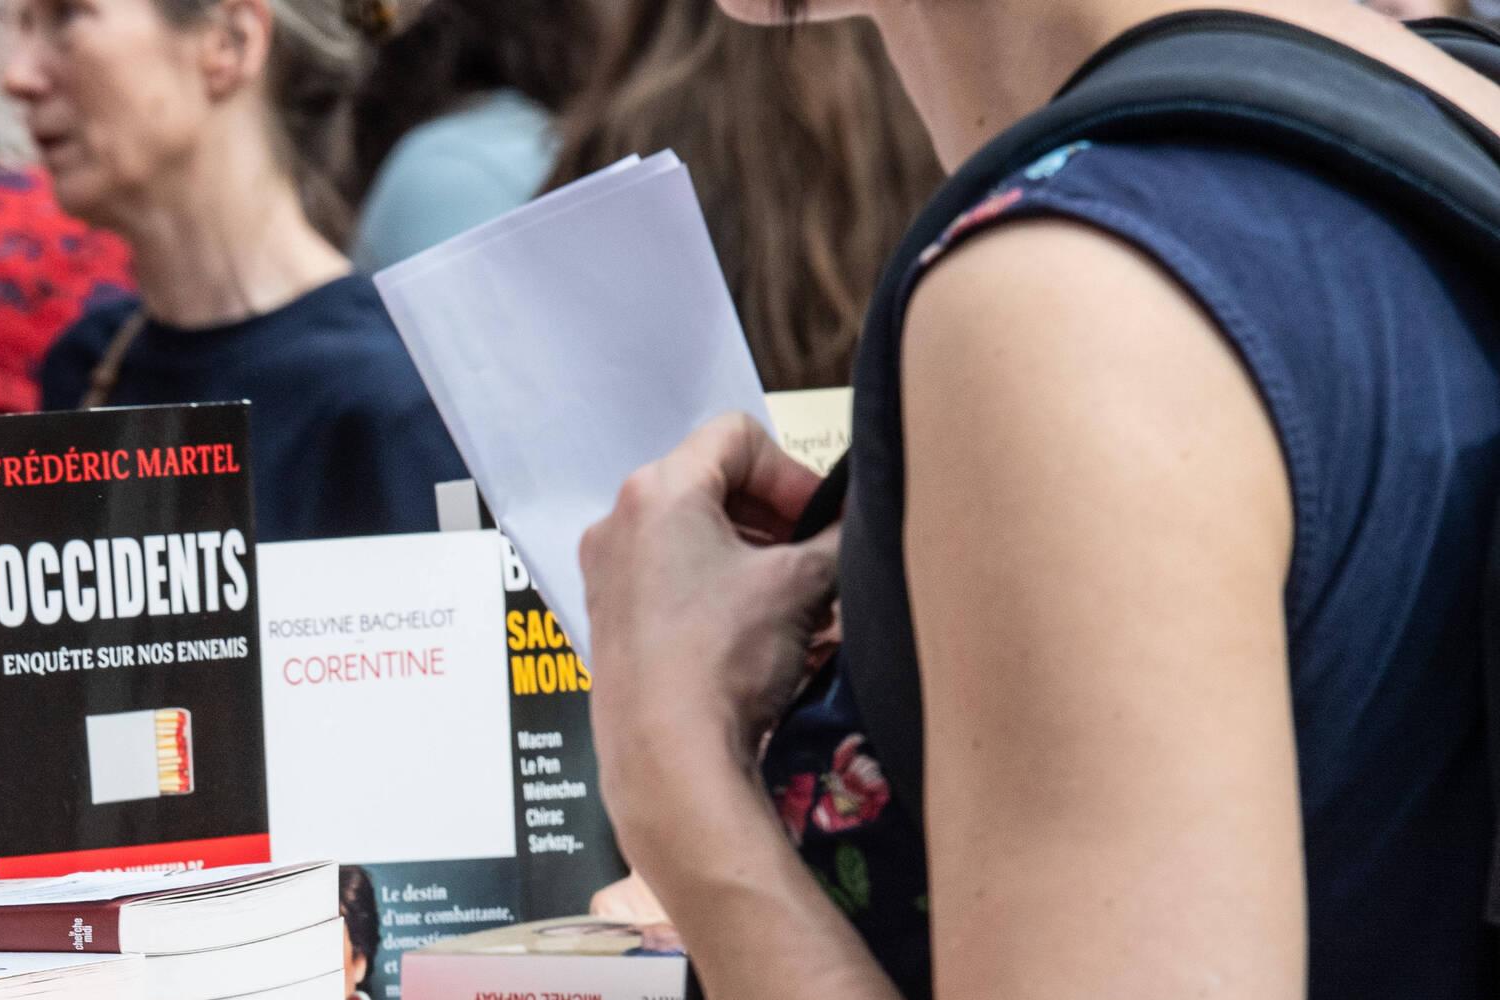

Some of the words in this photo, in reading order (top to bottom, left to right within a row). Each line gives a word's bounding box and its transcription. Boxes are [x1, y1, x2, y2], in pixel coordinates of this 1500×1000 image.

[137, 443, 240, 479] MARTEL
[269, 615, 353, 638] ROSELYNE
[360, 608, 455, 633] BACHELOT
[3, 647, 94, 676] ENQUÊTE
[97, 644, 135, 668] SUR
[137, 641, 173, 665] NOS
[177, 636, 248, 663] ENNEMIS
[283, 647, 445, 686] CORENTINE
[520, 757, 536, 776] Le
[536, 755, 561, 775] Pen
[72, 918, 84, 950] cherche
